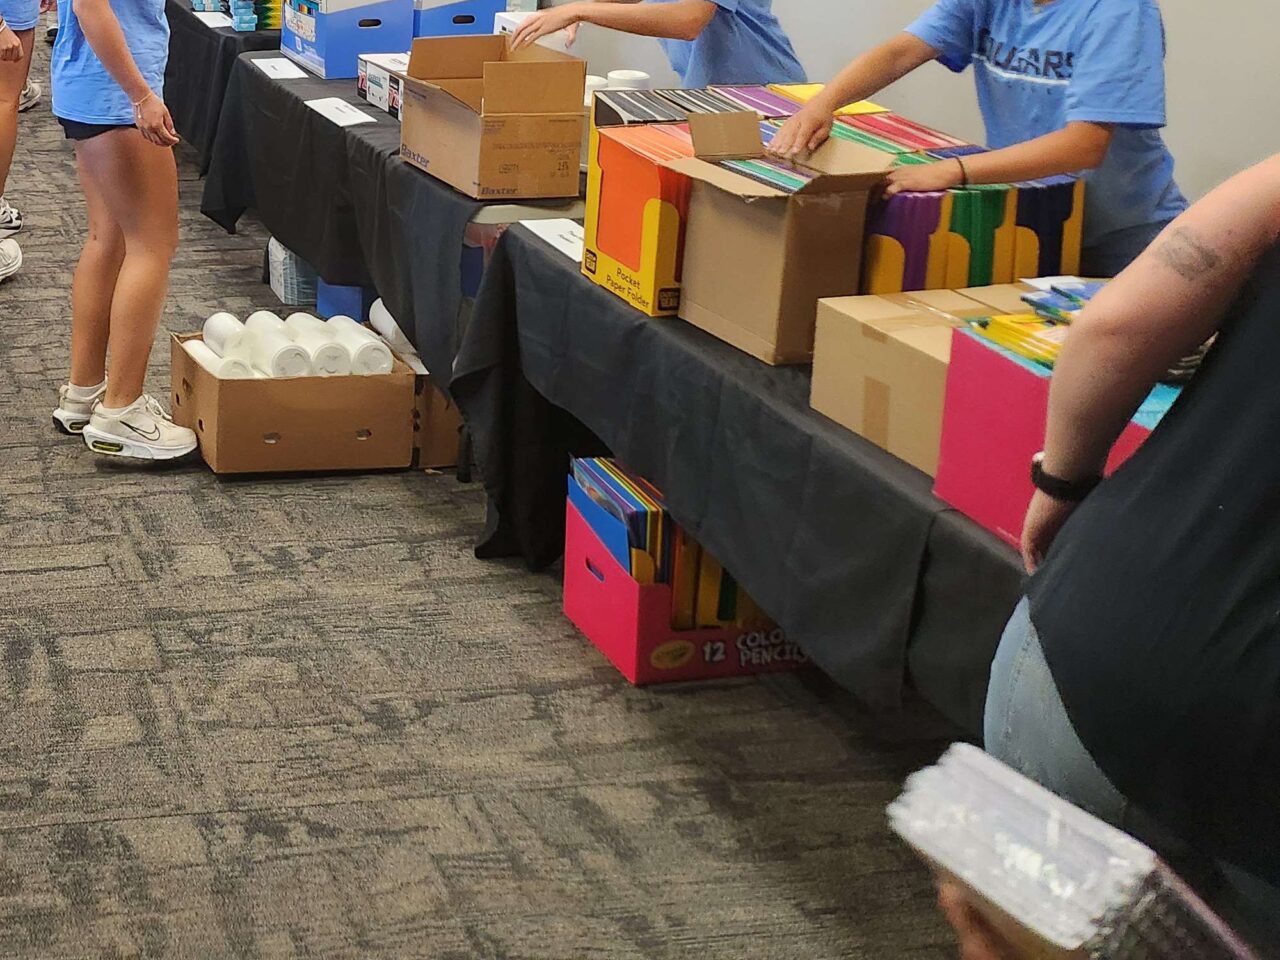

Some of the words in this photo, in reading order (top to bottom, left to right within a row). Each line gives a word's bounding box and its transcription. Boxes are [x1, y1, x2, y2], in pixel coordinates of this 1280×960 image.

[400, 143, 430, 168] Baxter
[481, 187, 518, 195] Baxter
[616, 267, 641, 289] Pocket
[606, 274, 626, 294] Paper
[627, 288, 650, 309] Folder
[703, 641, 725, 661] 12
[736, 628, 784, 649] COLO
